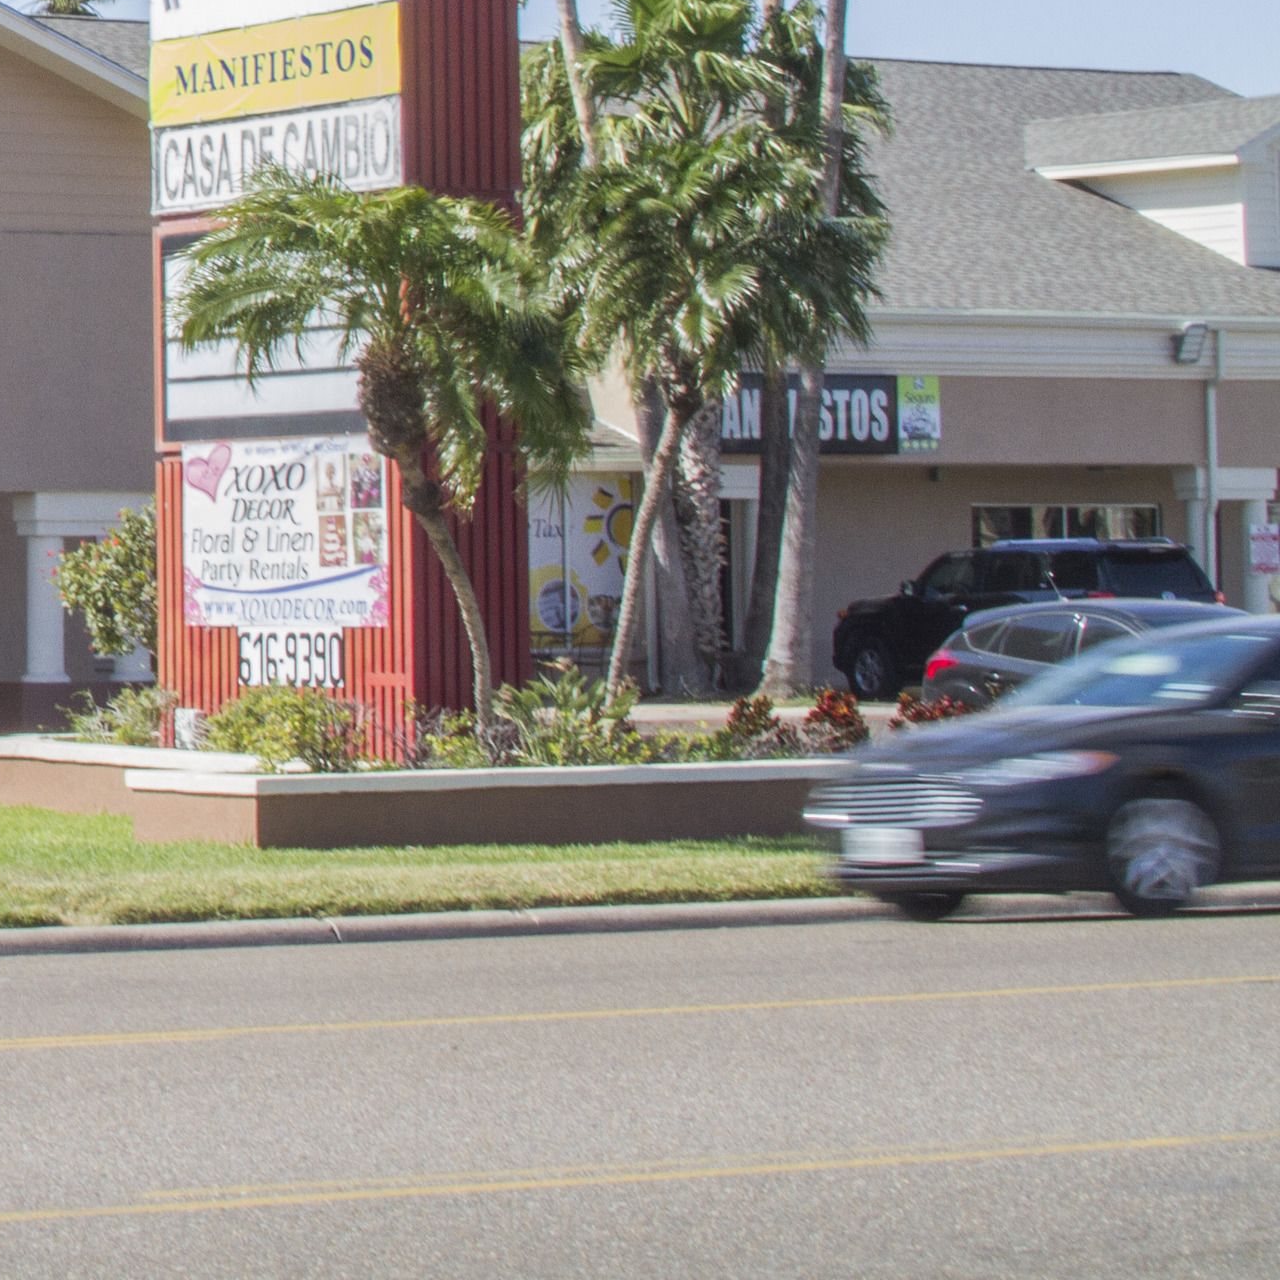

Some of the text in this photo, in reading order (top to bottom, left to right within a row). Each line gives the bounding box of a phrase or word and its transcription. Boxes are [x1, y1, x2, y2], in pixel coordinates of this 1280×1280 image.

[175, 35, 374, 96] MANIFIESTOS
[163, 132, 234, 201] CASA
[283, 110, 390, 189] CAMBIO
[224, 462, 306, 497] XOXO
[231, 497, 302, 526] DECOR
[191, 526, 315, 554] Floral & Linen
[201, 556, 310, 587] Party Rentals
[203, 598, 369, 623] www.XOXODECOR.com
